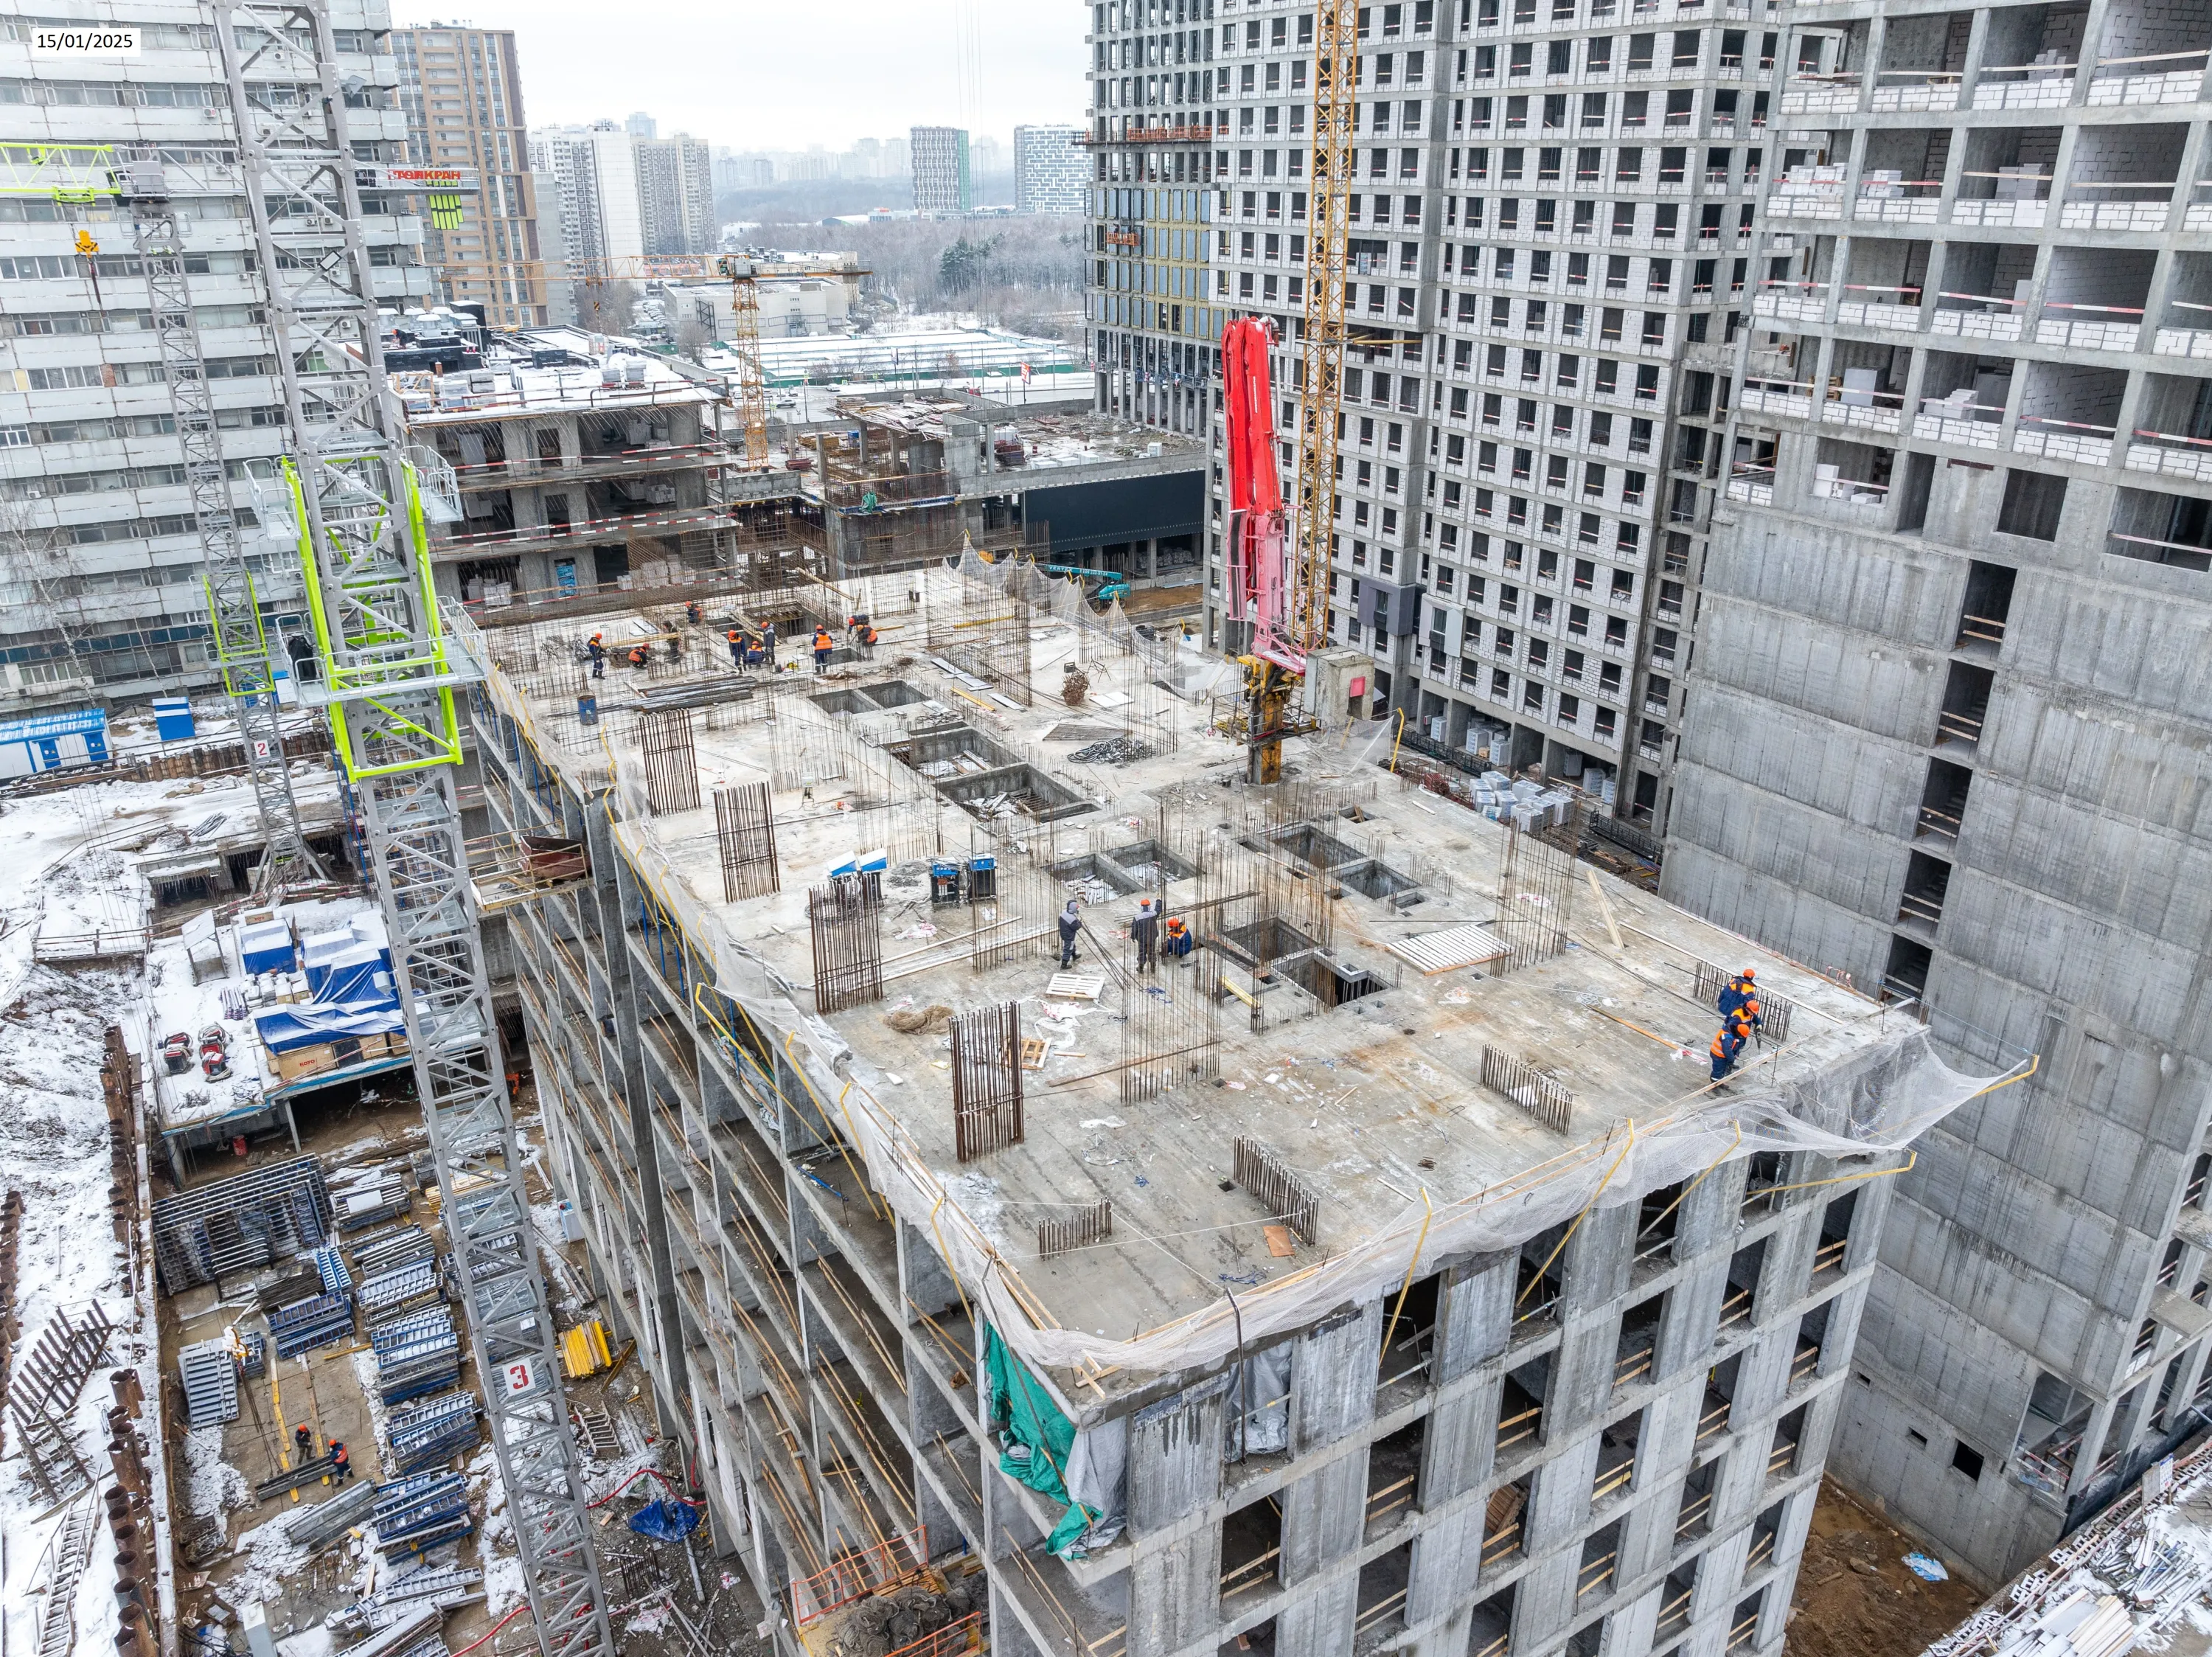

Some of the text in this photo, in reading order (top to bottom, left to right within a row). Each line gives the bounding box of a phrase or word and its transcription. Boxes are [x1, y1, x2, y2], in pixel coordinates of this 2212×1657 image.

[257, 743, 268, 756] 2
[299, 1059, 316, 1067] KOYO
[509, 1364, 529, 1390] 3
